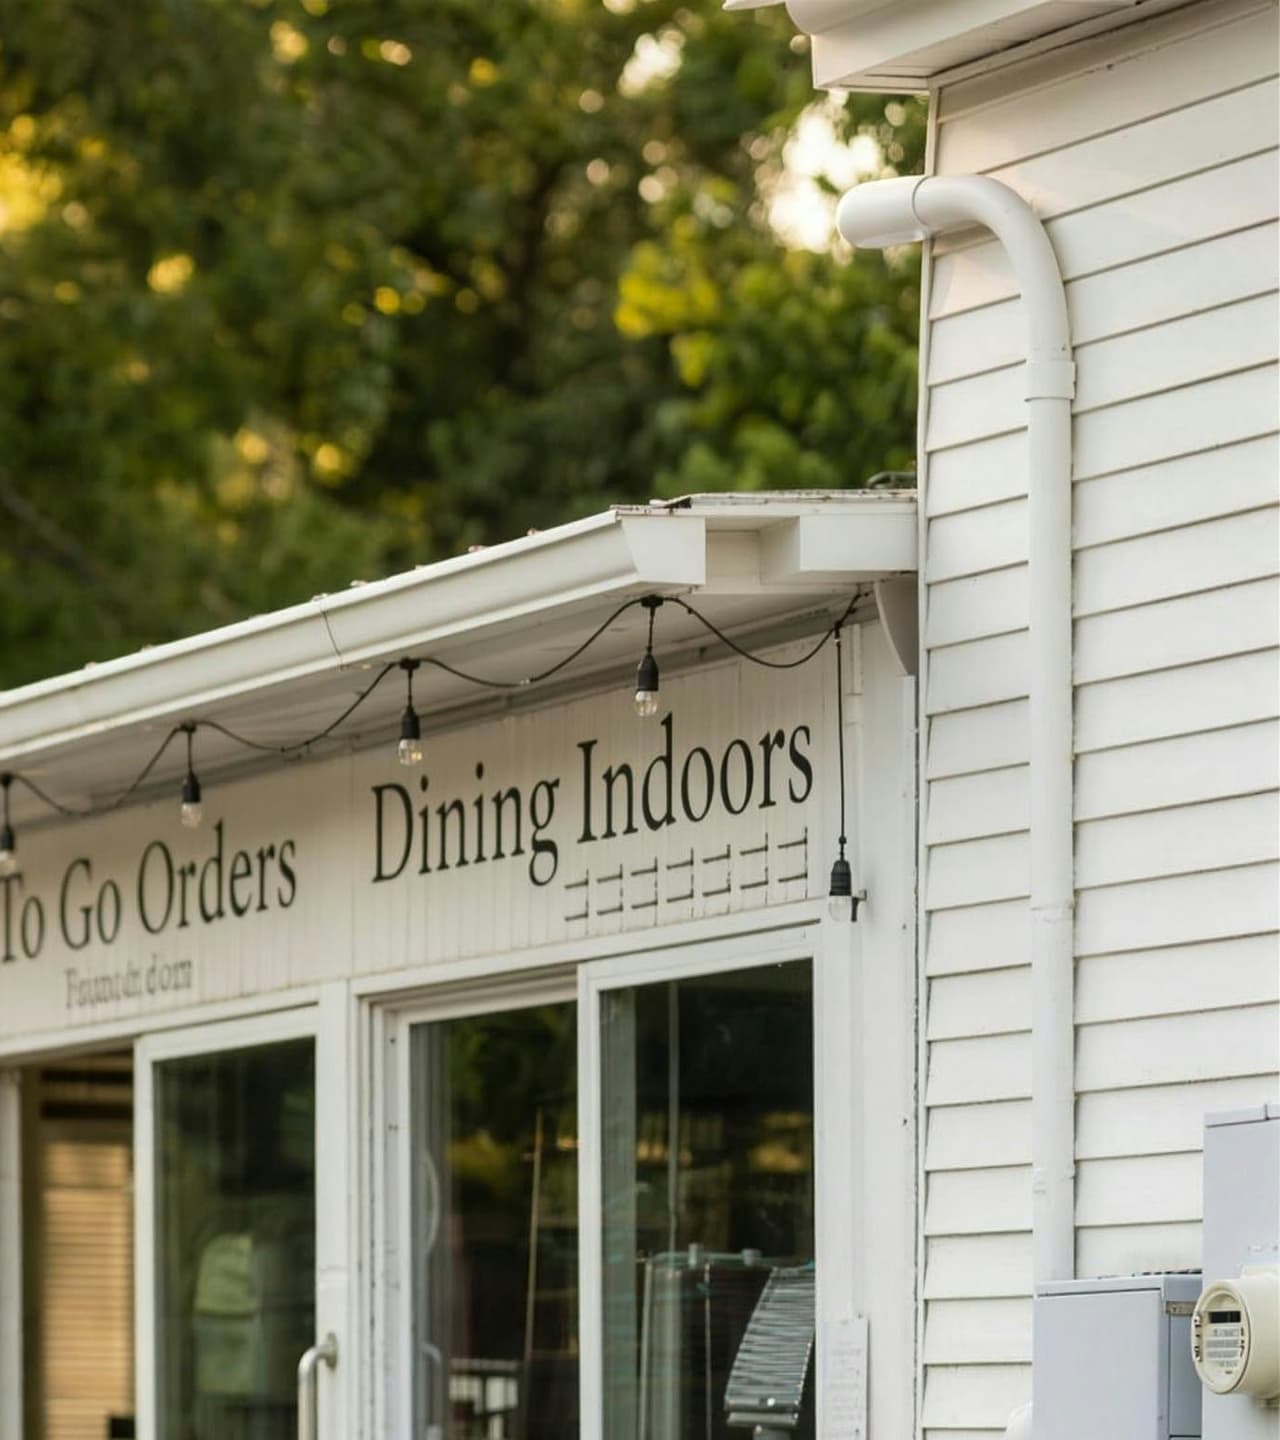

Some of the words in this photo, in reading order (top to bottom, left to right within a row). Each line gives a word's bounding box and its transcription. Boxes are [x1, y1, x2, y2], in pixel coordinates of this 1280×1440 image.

[372, 762, 559, 886] Dining
[577, 714, 813, 844] Indoors
[60, 858, 121, 950] Go
[137, 819, 296, 934] Orders
